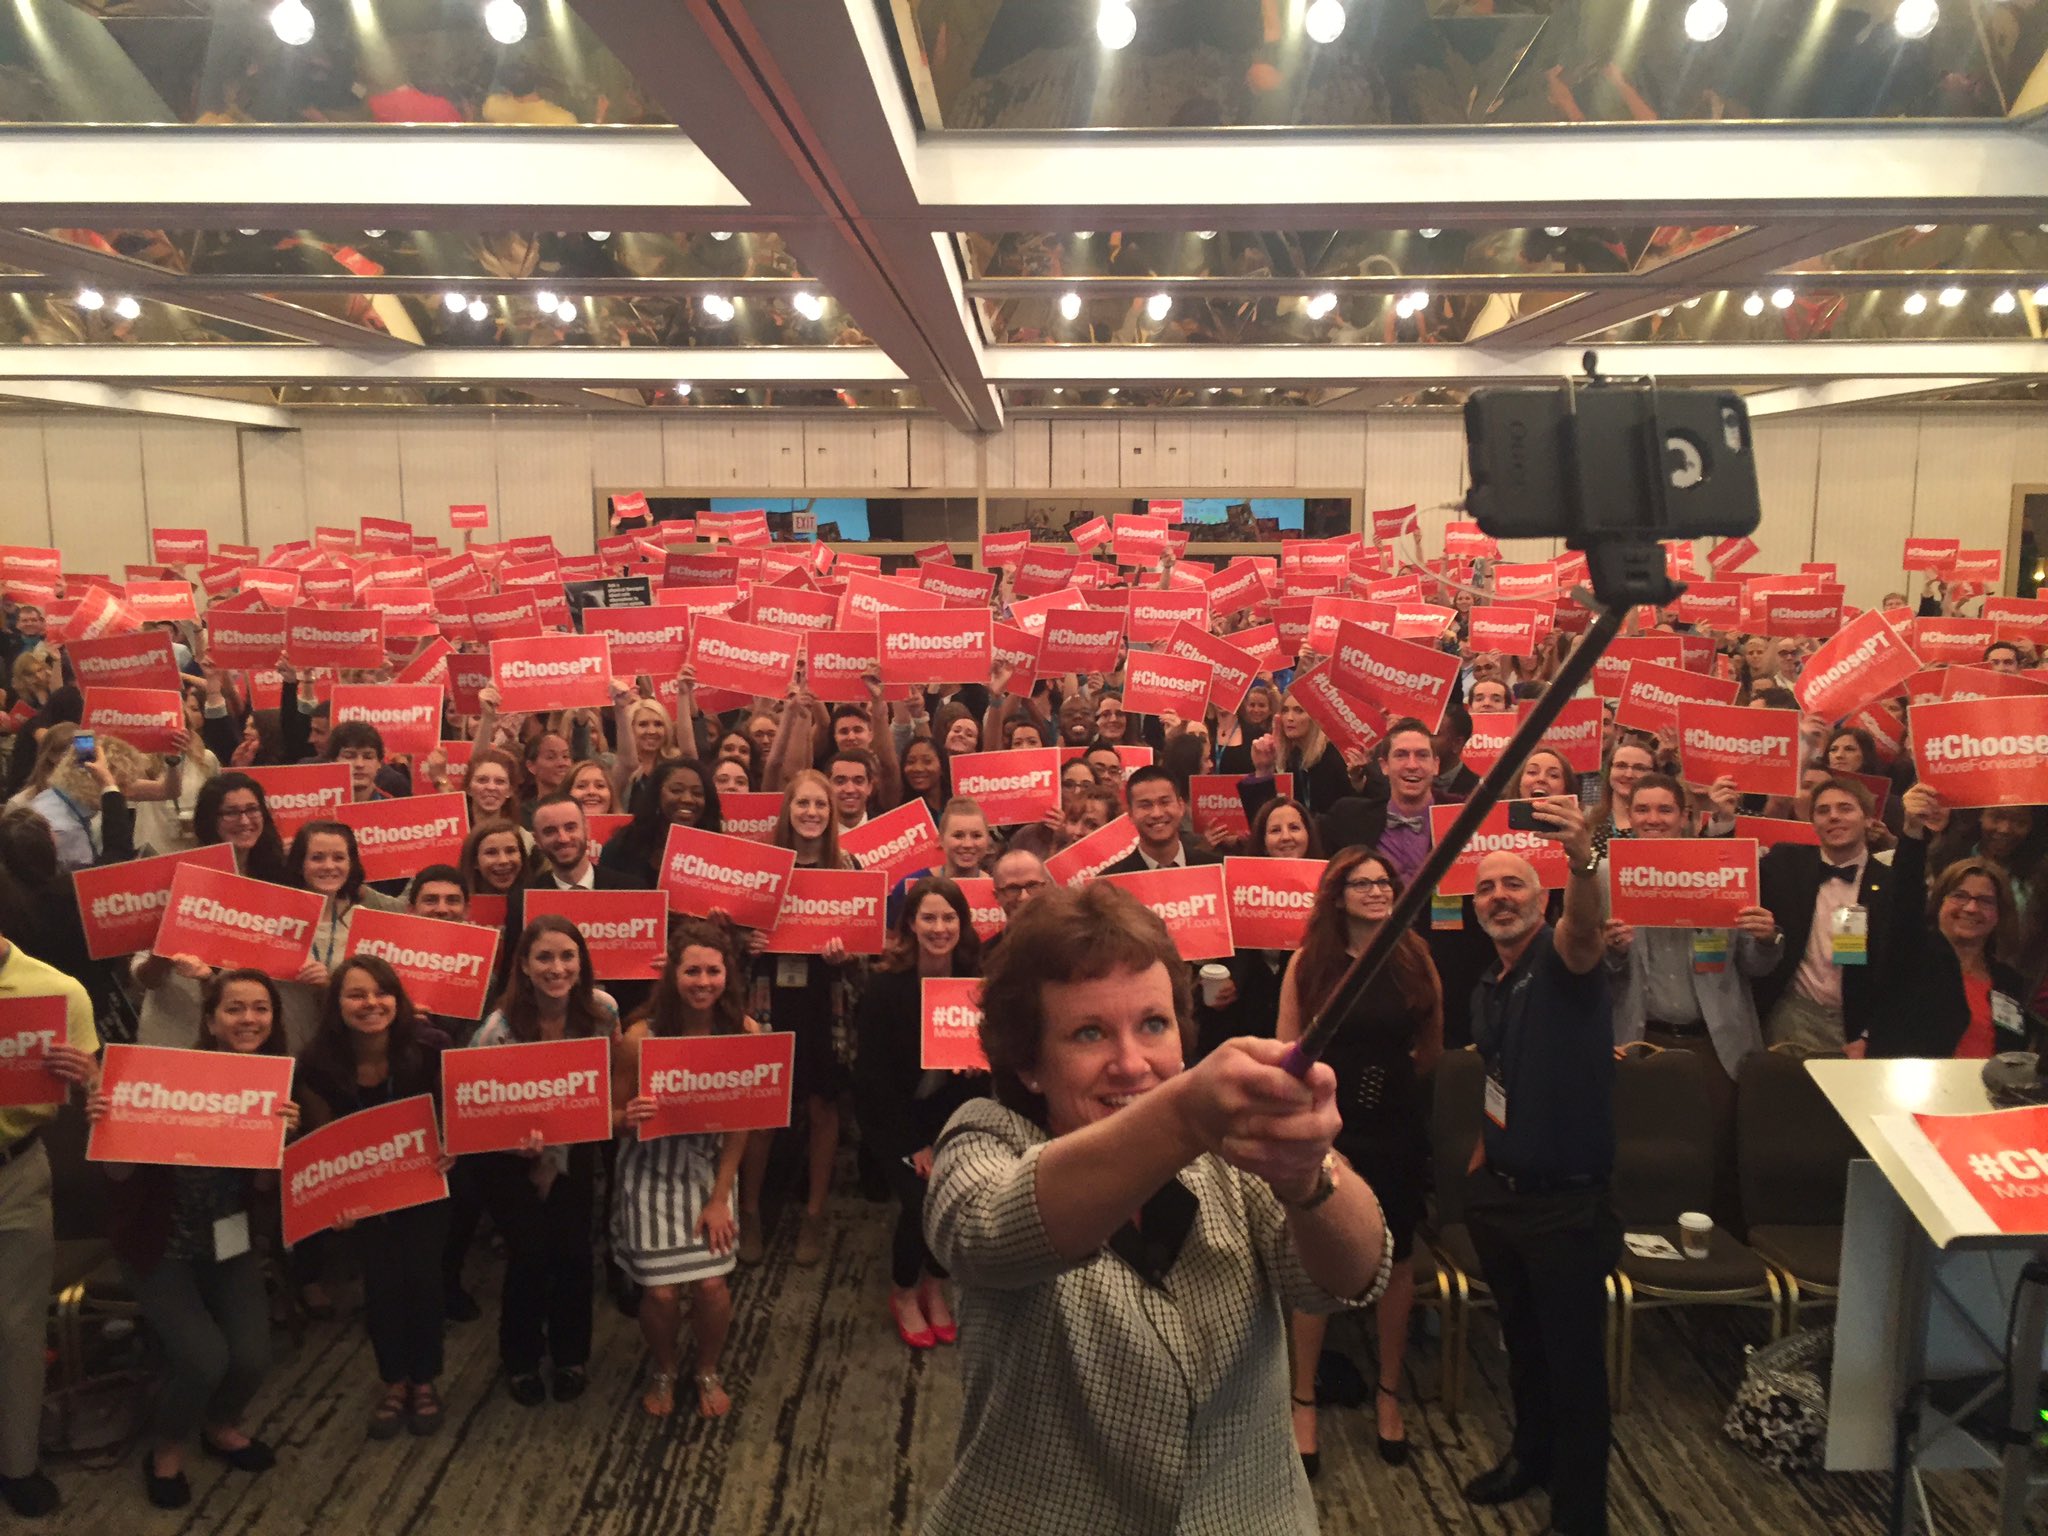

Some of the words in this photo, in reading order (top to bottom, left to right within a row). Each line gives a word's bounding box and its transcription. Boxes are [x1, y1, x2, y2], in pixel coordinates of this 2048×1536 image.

[796, 516, 815, 530] EXIT
[923, 579, 988, 598] #ChoosePT
[756, 607, 833, 629] #ChoosePT
[1134, 606, 1203, 620] #ChoosePT
[1771, 607, 1838, 619] #ChoosePT
[292, 627, 378, 641] #ChoosePT
[886, 631, 984, 650] #ChoosePT
[1049, 629, 1119, 646] #ChoosePT
[79, 650, 168, 672] #ChoosePT
[697, 638, 790, 669] #ChoosePT
[501, 657, 602, 678] #ChoosePT
[1340, 645, 1445, 696] #ChoosePT
[1131, 670, 1206, 694] #ChoosePT
[90, 709, 178, 727] #ChoosePT
[338, 706, 434, 722] #ChoosePT
[1312, 672, 1378, 744] #ChoosePT
[1684, 728, 1791, 756] #ChoosePT
[1925, 733, 2048, 761] #Choose
[1929, 753, 2048, 774] MoveForwardP
[959, 770, 1052, 794] #ChoosePT
[264, 787, 345, 809] oosePT
[854, 822, 928, 869] hoosePT
[670, 853, 781, 893] #ChoosePT
[1619, 867, 1748, 888] #ChoosePT
[93, 890, 169, 917] #Choo
[1233, 886, 1315, 907] #Choos
[1621, 887, 1748, 900] MoveForwardPT.com
[781, 894, 878, 916] ChoosePT
[1146, 894, 1217, 919] osePT
[178, 895, 309, 939] #ChoosePT
[578, 918, 658, 938] oosePT
[355, 938, 484, 976] #ChoosePT
[455, 1070, 599, 1106] #ChoosePT
[650, 1063, 783, 1094] #ChoosePT
[112, 1081, 277, 1116] #ChoosePT
[457, 1097, 600, 1119] MoveForwardPT.com
[111, 1109, 274, 1129] MoveForwardPT.com
[291, 1128, 426, 1196] #ChoosePT
